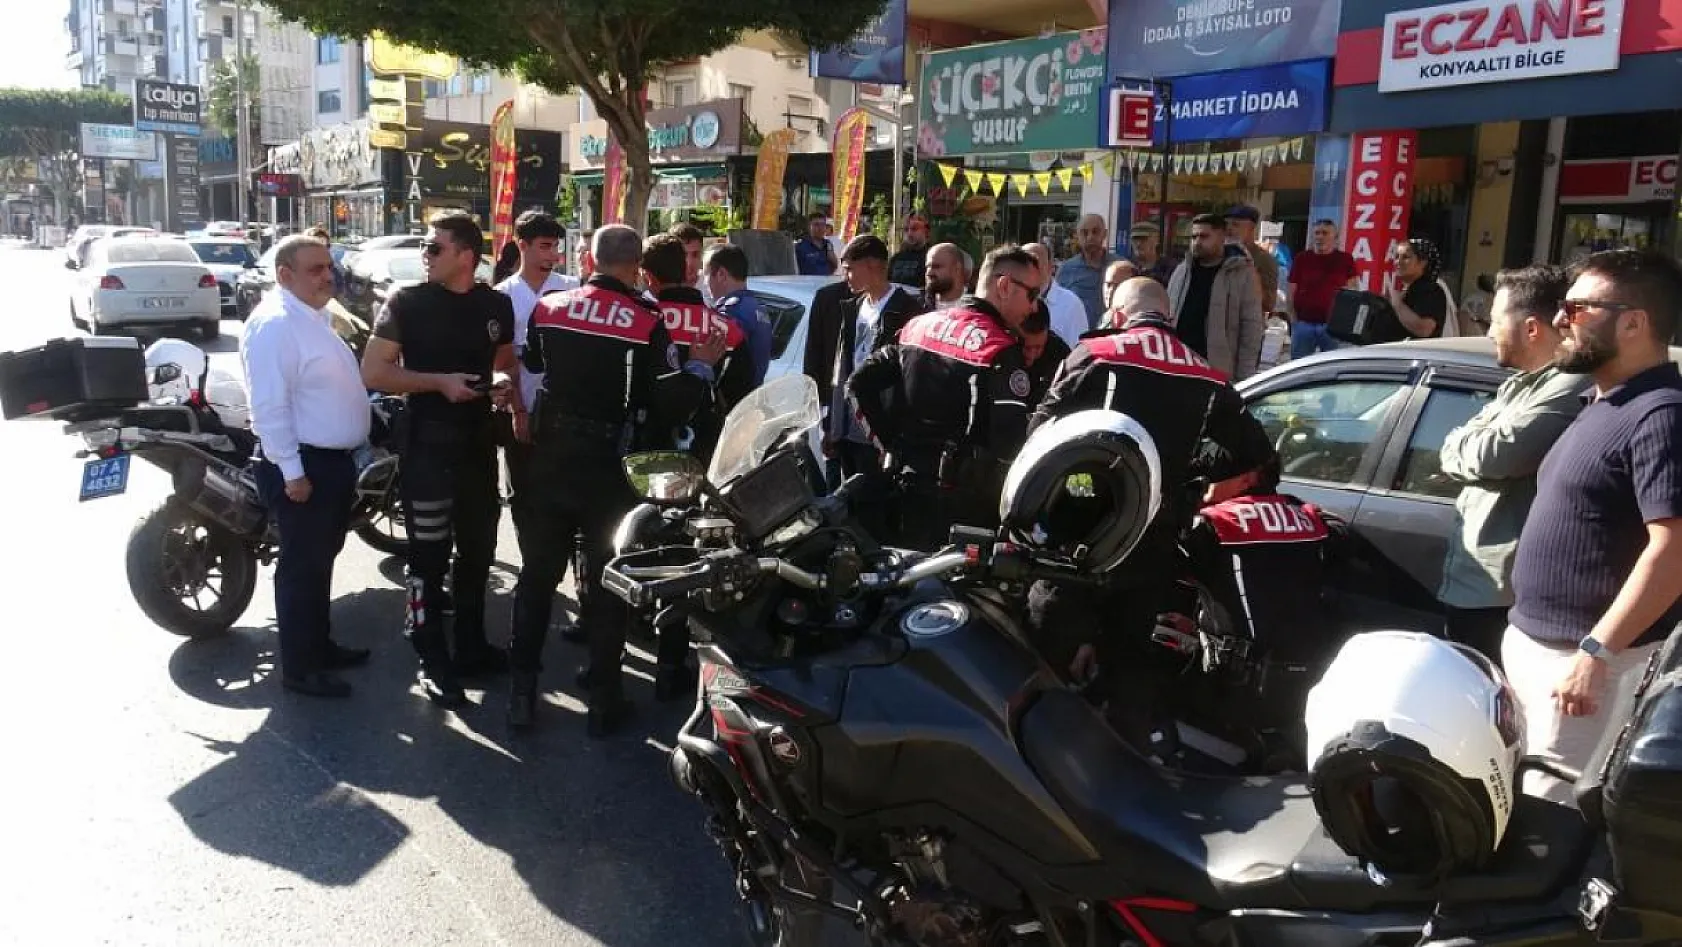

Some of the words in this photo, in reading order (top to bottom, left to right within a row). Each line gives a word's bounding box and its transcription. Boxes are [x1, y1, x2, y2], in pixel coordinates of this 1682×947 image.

[1195, 13, 1252, 37] SAYISAL
[1254, 6, 1292, 26] LOTO
[1391, 0, 1605, 59] ECZANE
[1419, 55, 1510, 79] KONYAALTI
[1514, 48, 1565, 69] BİLGE
[144, 83, 197, 109] talya
[931, 47, 1063, 123] ÇİÇEKÇİ
[1123, 97, 1149, 139] E
[1170, 96, 1237, 120] MARKET
[1239, 88, 1299, 114] İDDAA
[971, 116, 1028, 145] yusuf
[1352, 136, 1383, 292] ECZAN
[1381, 137, 1410, 296] ECZAN
[556, 297, 635, 328] OLİS
[110, 459, 121, 474] A
